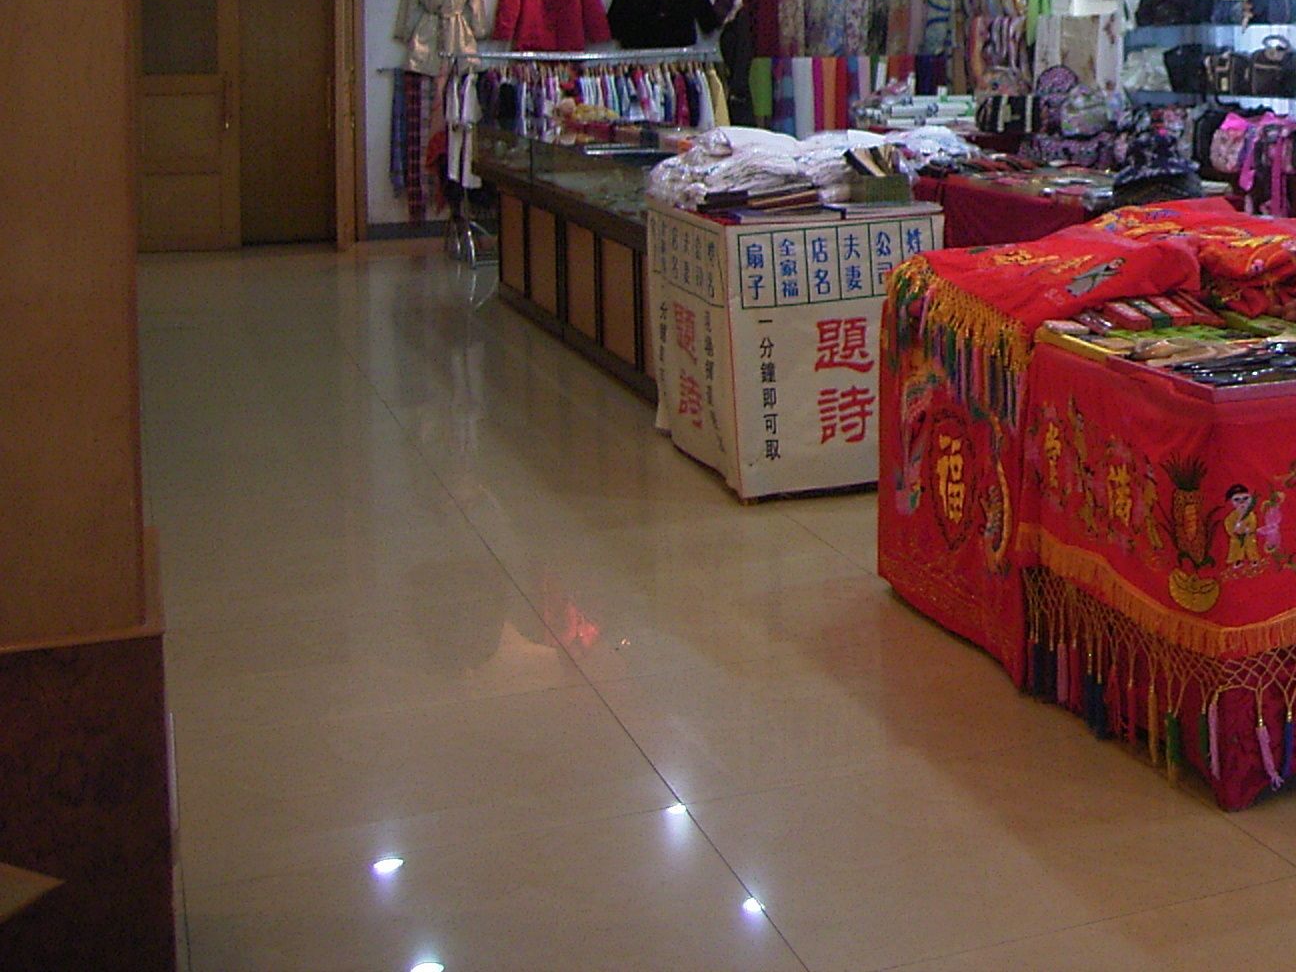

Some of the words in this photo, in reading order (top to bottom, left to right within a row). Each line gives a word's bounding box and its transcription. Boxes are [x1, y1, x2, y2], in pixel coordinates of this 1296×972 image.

[746, 243, 766, 301] 扇子
[779, 237, 799, 299] 全家福
[811, 236, 831, 295] 店名
[843, 233, 862, 293] 夫妻
[757, 318, 782, 461] 一分鐘即可取
[814, 316, 877, 445] 題詩
[936, 433, 966, 525] 福
